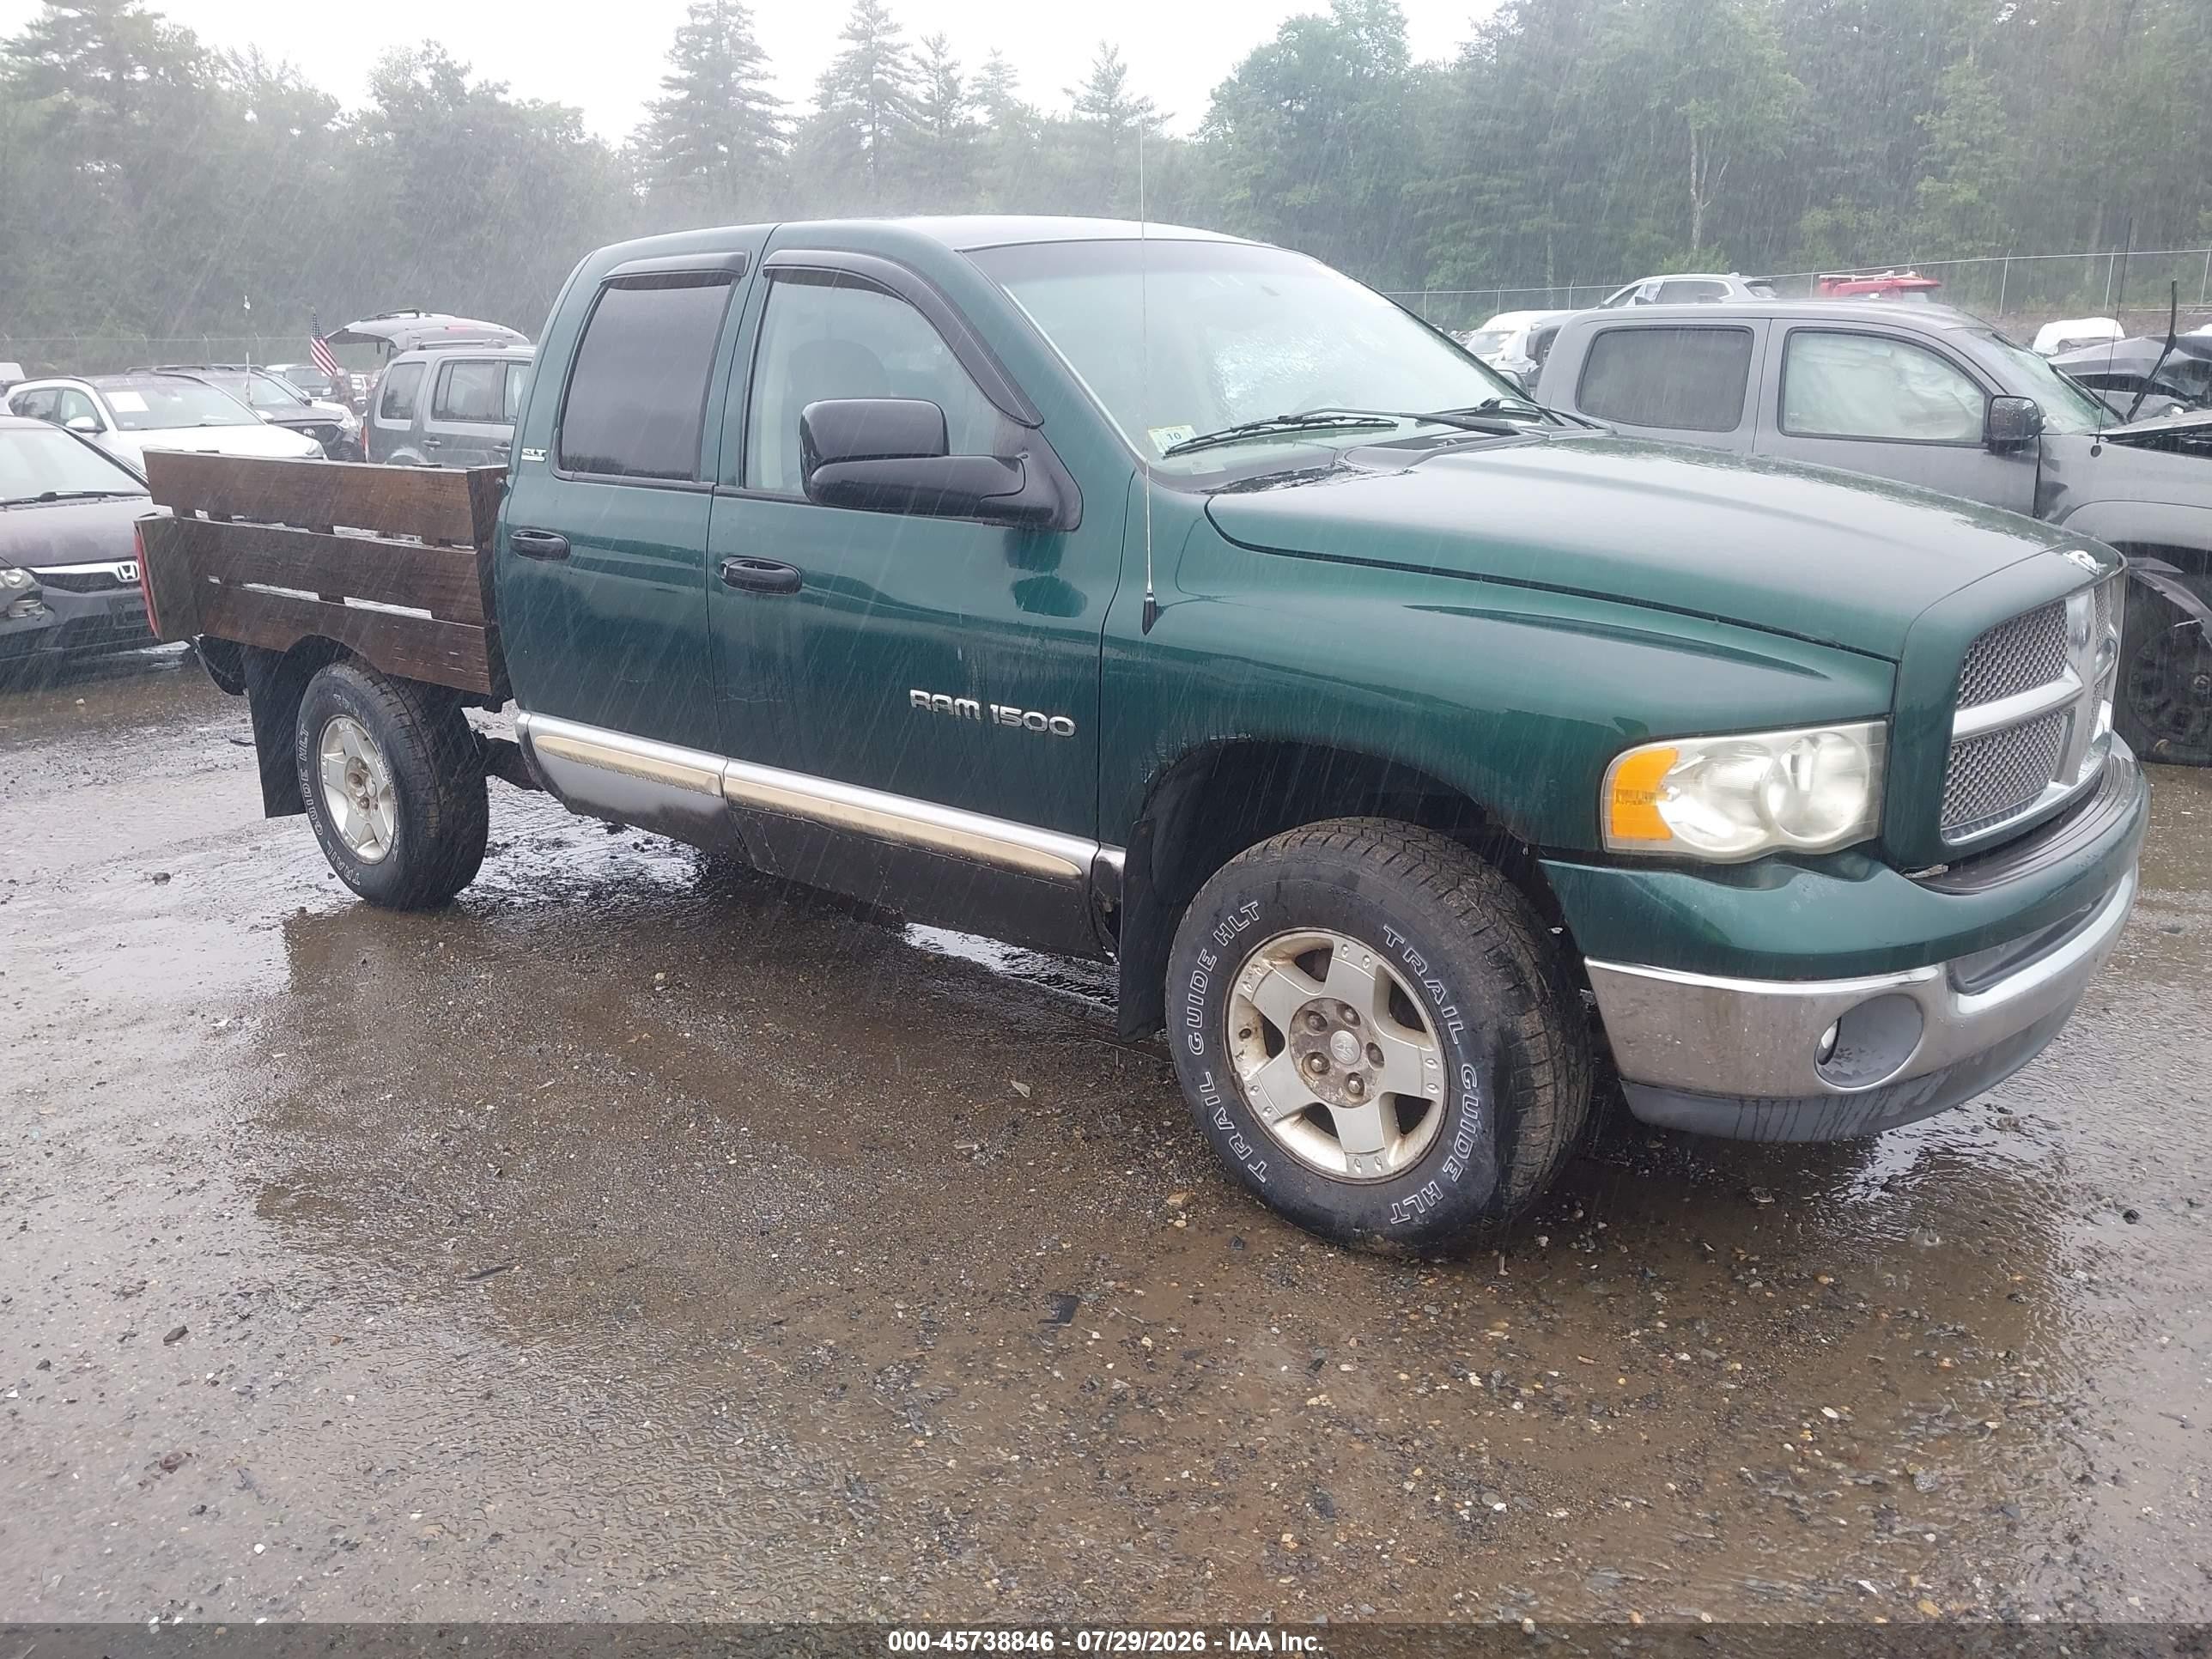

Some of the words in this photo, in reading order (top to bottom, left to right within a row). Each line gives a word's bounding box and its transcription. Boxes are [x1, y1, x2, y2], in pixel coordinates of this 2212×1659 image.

[522, 447, 547, 456] SLT
[1167, 432, 1182, 441] 10
[909, 689, 981, 720] RAM
[989, 704, 1076, 737] 1500
[299, 722, 310, 763] HLT
[299, 769, 324, 836] GUIDE
[326, 840, 361, 886] TRAIL
[1213, 901, 1262, 946] HLT
[1186, 949, 1218, 1055] GUIDE
[1383, 924, 1465, 1045] TRAIL
[1199, 1072, 1269, 1182] TRAIL
[1443, 1064, 1481, 1182] GUIDE
[1390, 1182, 1443, 1224] HLT
